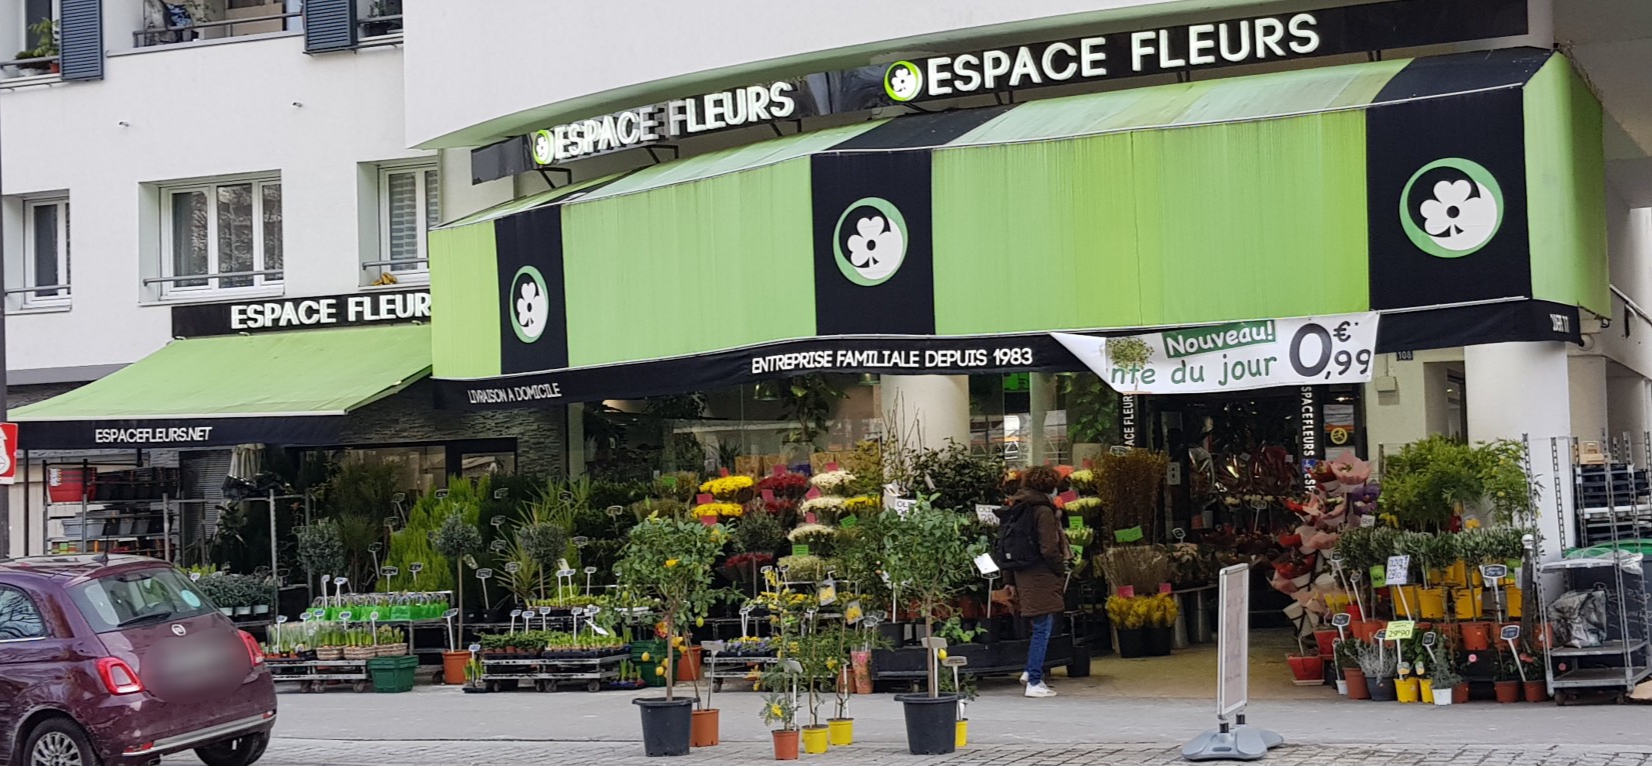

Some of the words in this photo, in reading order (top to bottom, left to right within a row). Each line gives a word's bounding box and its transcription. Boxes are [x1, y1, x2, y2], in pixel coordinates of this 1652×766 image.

[927, 37, 1107, 96] ESPACE
[1131, 13, 1320, 71] FLEURS
[554, 106, 659, 159] ESPACE
[668, 81, 795, 135] FLEURS
[231, 299, 337, 329] ESPACE
[1166, 320, 1274, 356] Nouveau!
[752, 350, 833, 374] ENTREPRISE
[836, 350, 920, 367] FAMILIALE
[925, 349, 988, 367] DEPUIS
[993, 347, 1033, 366] 1983
[1170, 359, 1205, 385] du
[1218, 353, 1277, 386] jour
[467, 387, 508, 404] LIVRAISON
[514, 382, 562, 401] DOMICILE
[95, 426, 213, 443] ESPACEFLEURS.NET
